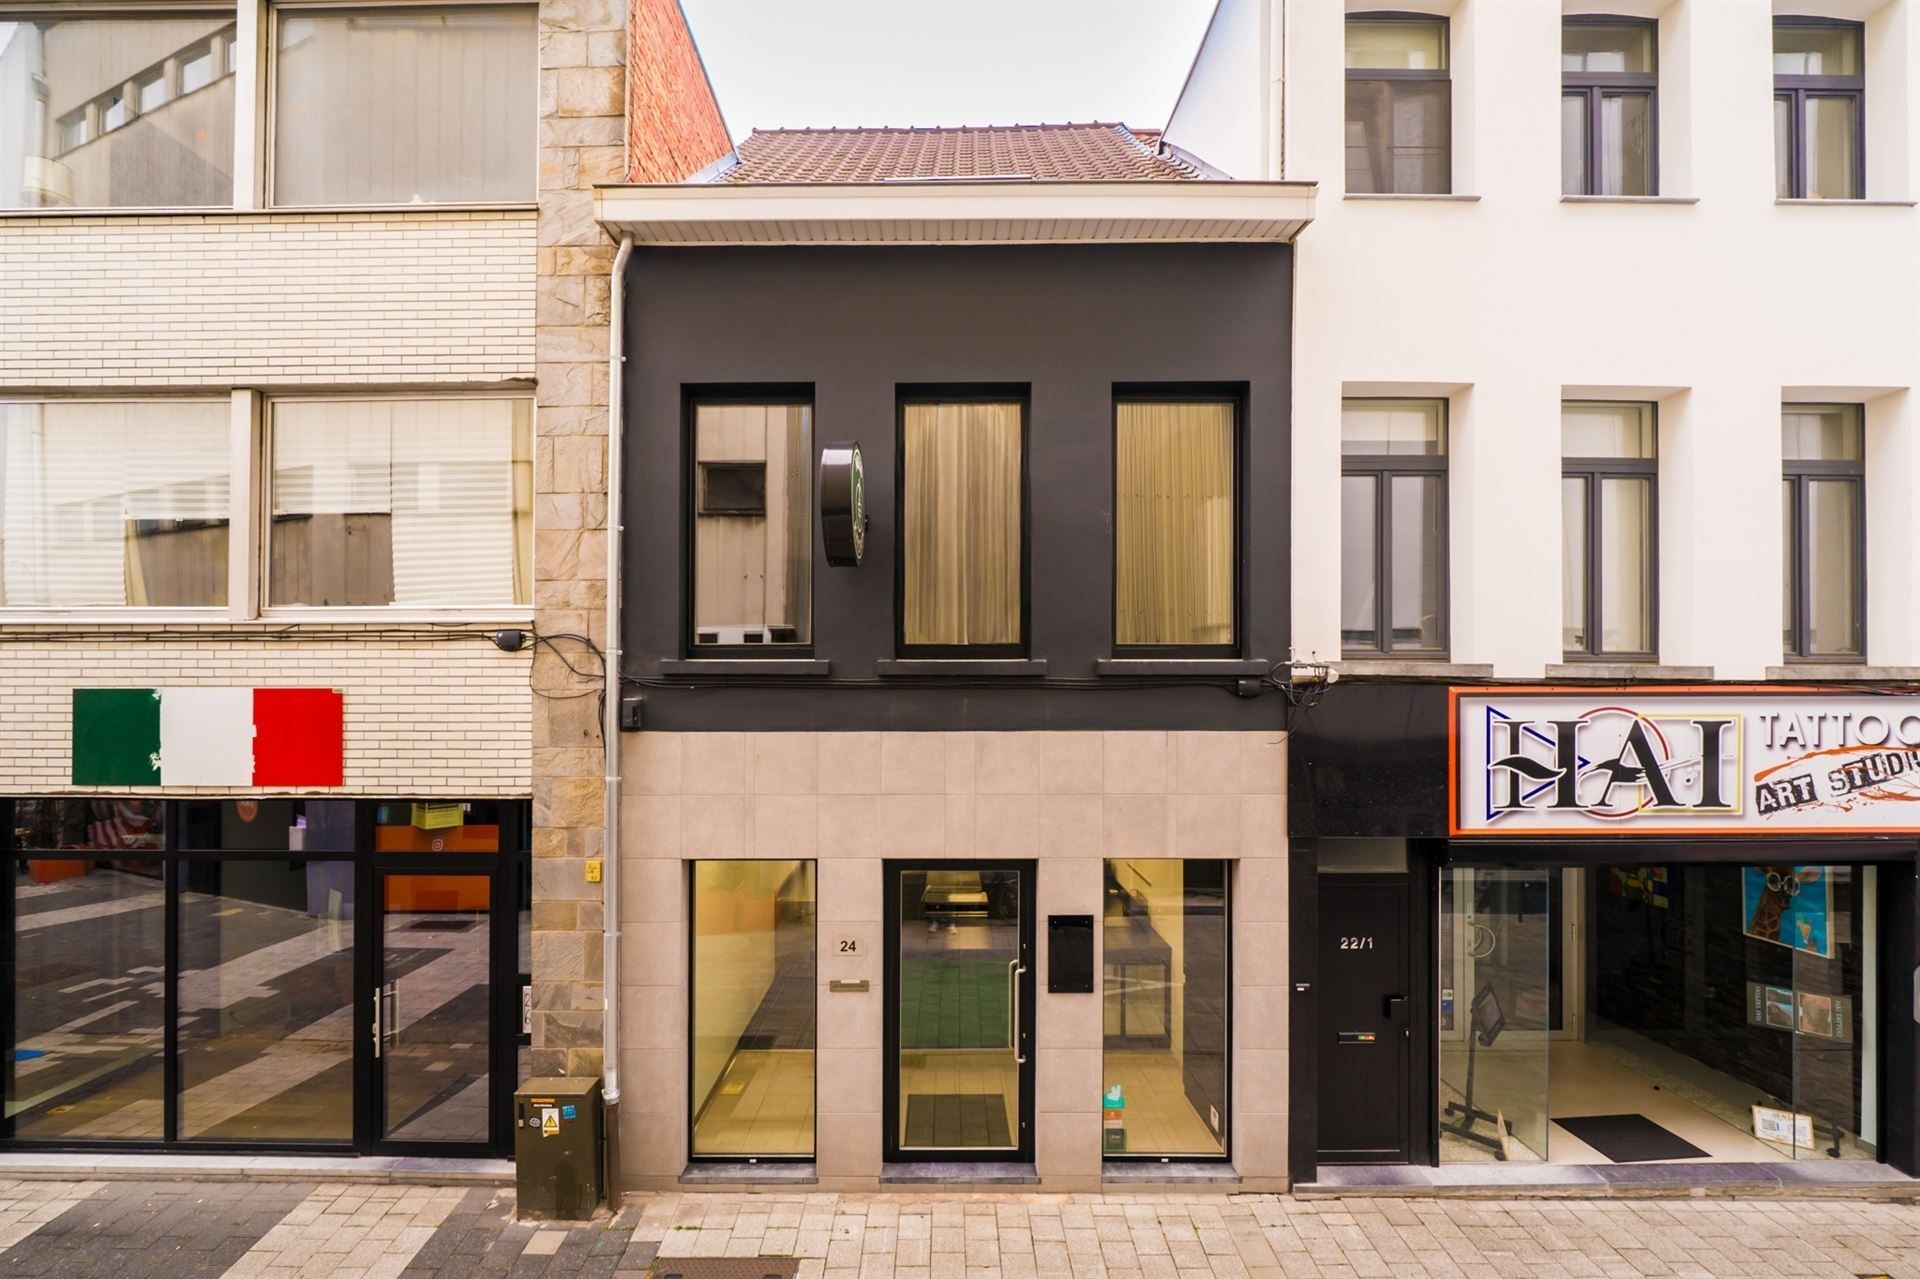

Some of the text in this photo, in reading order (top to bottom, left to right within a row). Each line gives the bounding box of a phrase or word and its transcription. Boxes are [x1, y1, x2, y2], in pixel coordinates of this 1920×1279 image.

[1760, 712, 1920, 748] TATTOO
[1489, 719, 1735, 810] HAI
[1757, 774, 1818, 815] ART
[840, 940, 856, 952] 24
[1340, 937, 1373, 949] 22/1
